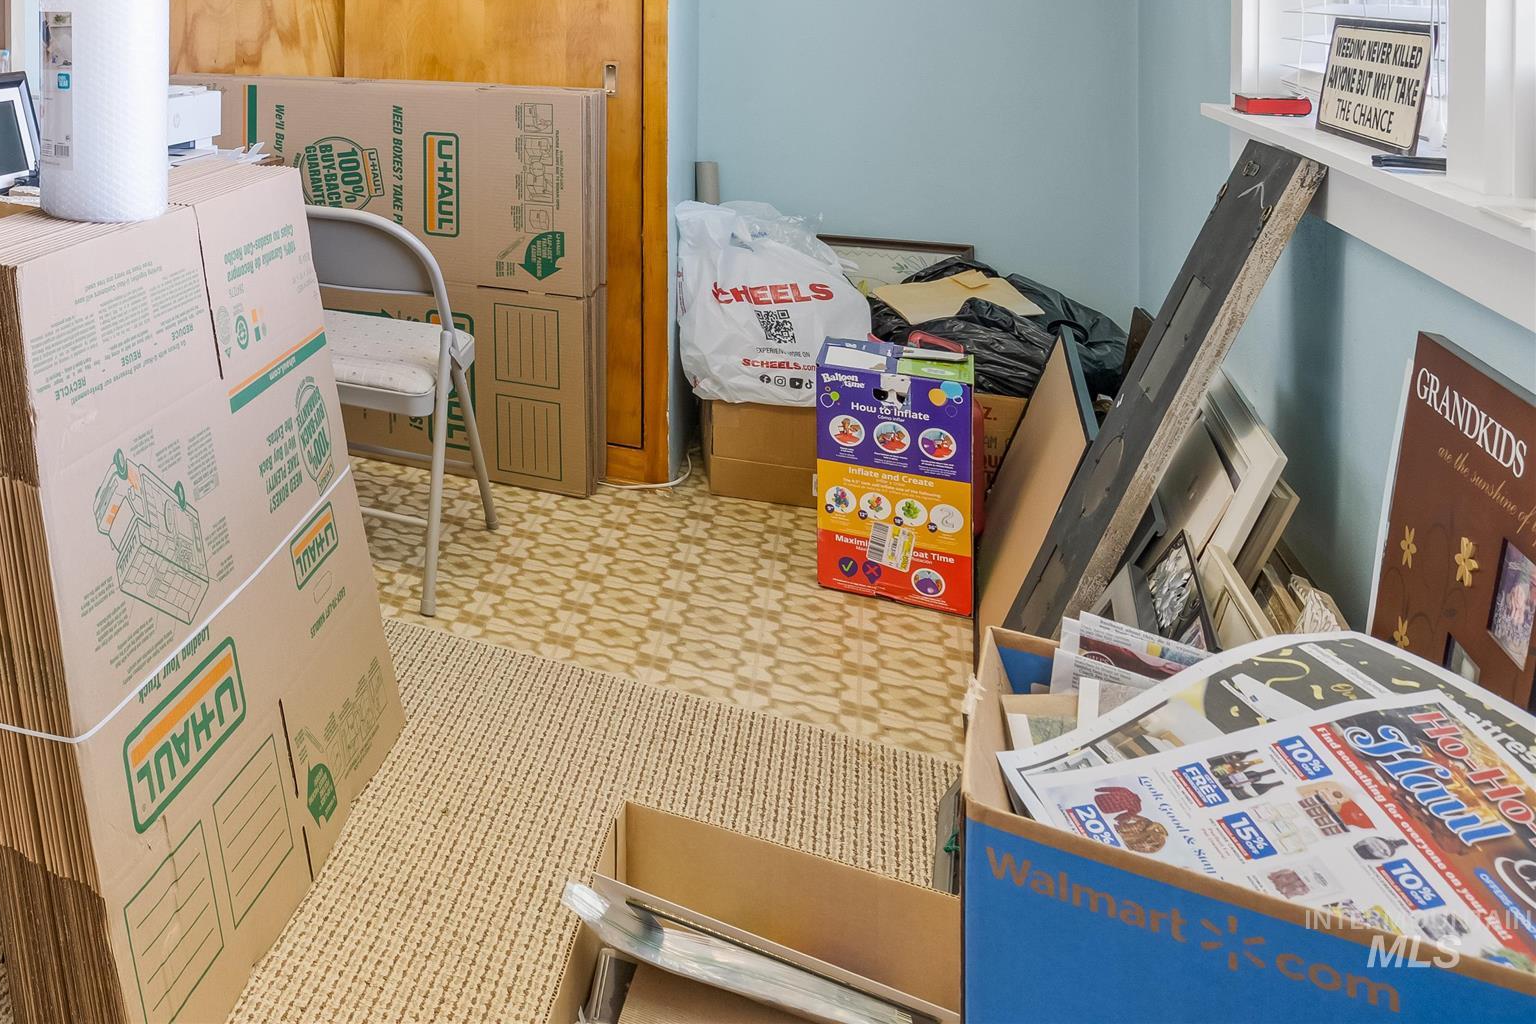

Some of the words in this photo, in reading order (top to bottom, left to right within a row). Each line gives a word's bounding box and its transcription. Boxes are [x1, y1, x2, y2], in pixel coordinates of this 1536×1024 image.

[1336, 36, 1366, 59] WEEDING
[1367, 40, 1392, 66] NEVER
[1392, 44, 1423, 70] KILLED
[1327, 63, 1356, 93] ANYONE
[1355, 69, 1374, 96] BUT
[1374, 72, 1396, 100] WHY
[1396, 76, 1420, 107] TAKE
[275, 104, 284, 130] We'll
[392, 105, 403, 135] NEED
[1336, 98, 1352, 122] THE
[1353, 103, 1395, 134] CHANCE
[274, 132, 284, 153] Buy
[392, 138, 403, 181] BOXES?
[305, 145, 326, 206] GUARANTE
[337, 147, 366, 204] 100%
[368, 151, 382, 194] U-HAUL
[438, 140, 454, 230] U-HAUL
[392, 184, 403, 212] TAKE
[171, 323, 194, 342] REDUCE
[120, 349, 142, 367] REUSE
[54, 376, 86, 400] RECYCLE
[821, 372, 858, 383] Balloon
[843, 380, 864, 388] time
[851, 402, 876, 414] How
[879, 406, 890, 416] to
[894, 407, 930, 421] Inflate
[1416, 367, 1528, 478] GRANDKIDS
[258, 454, 274, 478] Back
[286, 452, 300, 476] TAKE
[307, 427, 330, 474] 100%
[266, 464, 287, 495] PLENTY!
[289, 470, 303, 495] NEED
[848, 466, 880, 479] Inflate
[882, 470, 900, 482] and
[902, 476, 934, 488] Create
[1438, 446, 1452, 466] are
[1454, 452, 1469, 476] the
[1470, 469, 1517, 516] sunshine
[1516, 505, 1535, 534] of
[270, 483, 289, 514] BOXES?
[296, 522, 336, 576] U-HAUL
[835, 534, 868, 546] Maximi
[931, 553, 955, 564] Time
[182, 624, 210, 661] Loading
[163, 652, 181, 680] Your
[138, 676, 162, 704] Truck
[136, 676, 238, 803] U-HAUL
[1284, 738, 1324, 772] 10%
[1467, 712, 1536, 768] attres
[1184, 765, 1222, 803] FREE
[1300, 762, 1315, 775] OFF
[1408, 711, 1536, 848] HO-HO-
[1344, 726, 1514, 846] Haul
[1074, 805, 1113, 844] 20%
[1138, 776, 1162, 802] Look
[1160, 803, 1189, 833] Good
[1184, 835, 1195, 846] &
[1316, 728, 1338, 750] Find
[1336, 746, 1387, 805] something
[1383, 800, 1404, 822] for
[1398, 818, 1447, 873] everyone
[1444, 869, 1462, 888] on
[1456, 884, 1487, 918] your
[1230, 816, 1267, 850] 15%
[1244, 840, 1259, 853] OFF
[986, 846, 1190, 944] Walmart
[1390, 862, 1436, 902] 10%
[1409, 889, 1426, 904] OFF
[1276, 951, 1402, 1014] com
